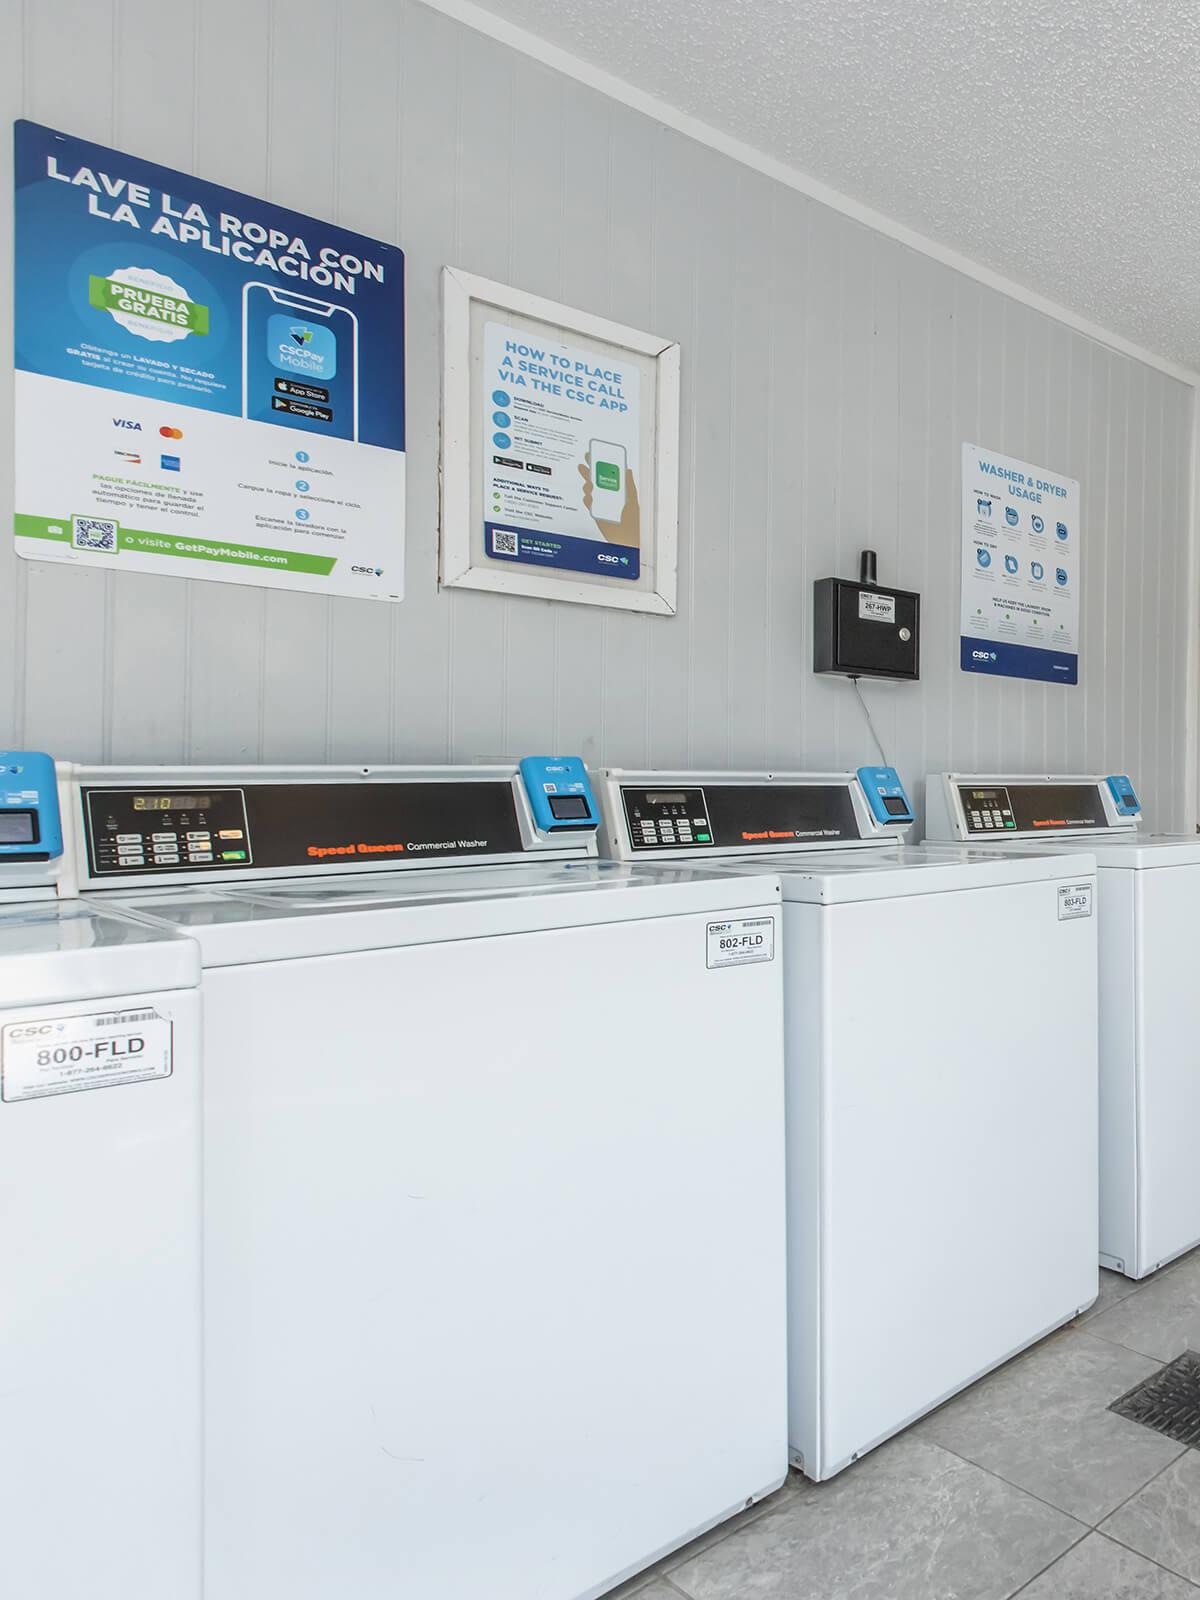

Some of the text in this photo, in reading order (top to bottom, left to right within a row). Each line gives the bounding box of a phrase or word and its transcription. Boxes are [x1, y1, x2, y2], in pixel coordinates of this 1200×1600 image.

[47, 156, 384, 283] LAVE LA ROPA CON
[89, 194, 355, 295] LA APLICACIÓN
[111, 284, 190, 315] PRUEBA
[118, 299, 188, 325] GRATIS
[66, 347, 101, 361] GRATIS
[279, 344, 324, 363] CSCPay
[133, 354, 170, 369] LAVADO
[179, 366, 215, 379] SECADO
[280, 354, 323, 373] Mobile
[505, 340, 623, 385] HOW TO PLACE
[502, 355, 625, 399] A SERVICE CALL
[289, 387, 305, 396] App
[306, 390, 326, 400] Store
[498, 368, 527, 386] VIA
[531, 377, 563, 396] THE
[566, 388, 595, 405] CSC
[599, 398, 628, 413] APP
[289, 405, 315, 417] Google
[315, 411, 330, 421] Play
[112, 418, 142, 431] VISA
[92, 473, 124, 484] PAGUE
[493, 477, 526, 488] ADDITIONAL
[493, 483, 511, 491] PLACE
[979, 460, 1067, 498] WASHER & DRYER
[114, 485, 153, 497] opciones
[1008, 484, 1042, 504] USAGE
[95, 497, 127, 507] tiempo
[136, 502, 159, 511] tener
[125, 535, 289, 566] o visite GetPayMobile.com
[597, 553, 619, 563] CSC
[351, 565, 374, 574] CSC
[972, 650, 989, 659] CSC
[307, 840, 488, 858] Speed Queen Commercial Washer
[709, 924, 727, 932] CSC
[719, 935, 763, 949] 802-FLD
[9, 1025, 53, 1038] CSC
[37, 1038, 145, 1066] 800-FLD
